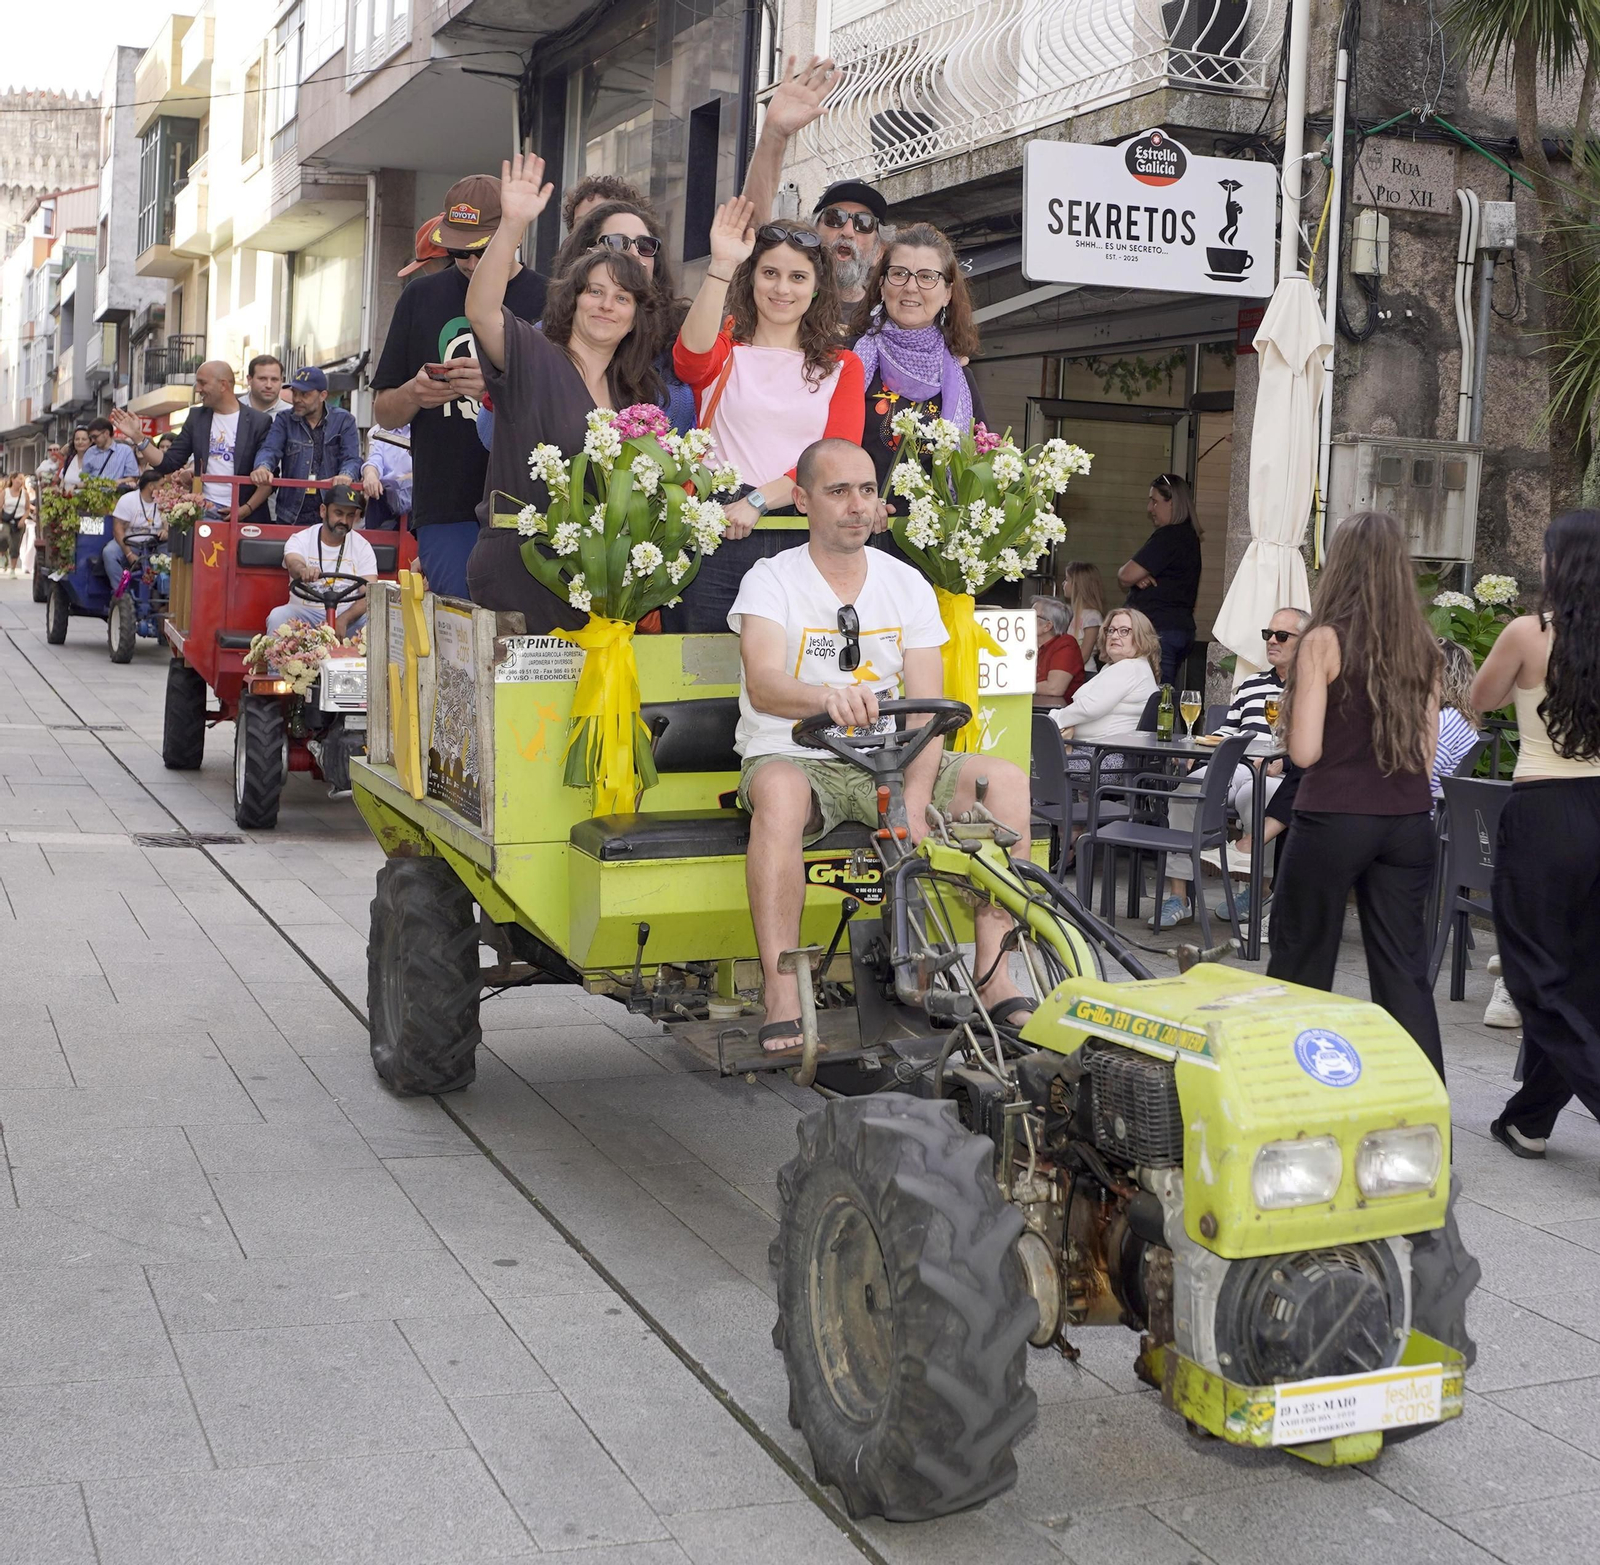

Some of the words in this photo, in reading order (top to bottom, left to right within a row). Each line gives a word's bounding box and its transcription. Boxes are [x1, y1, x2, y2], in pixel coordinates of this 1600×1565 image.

[1135, 146, 1177, 163] Estrella
[1136, 159, 1175, 175] Galicia
[1408, 189, 1434, 208] XII
[451, 211, 477, 220] TOYOTA
[1047, 198, 1196, 246] SEKRETOS
[1075, 240, 1103, 250] SHHH...
[1116, 243, 1127, 251] UN
[1129, 244, 1169, 255] SECRETO...
[814, 646, 836, 660] cans
[1076, 1001, 1112, 1026] Grillo
[1385, 1378, 1433, 1408] festival
[1396, 1400, 1436, 1424] cans
